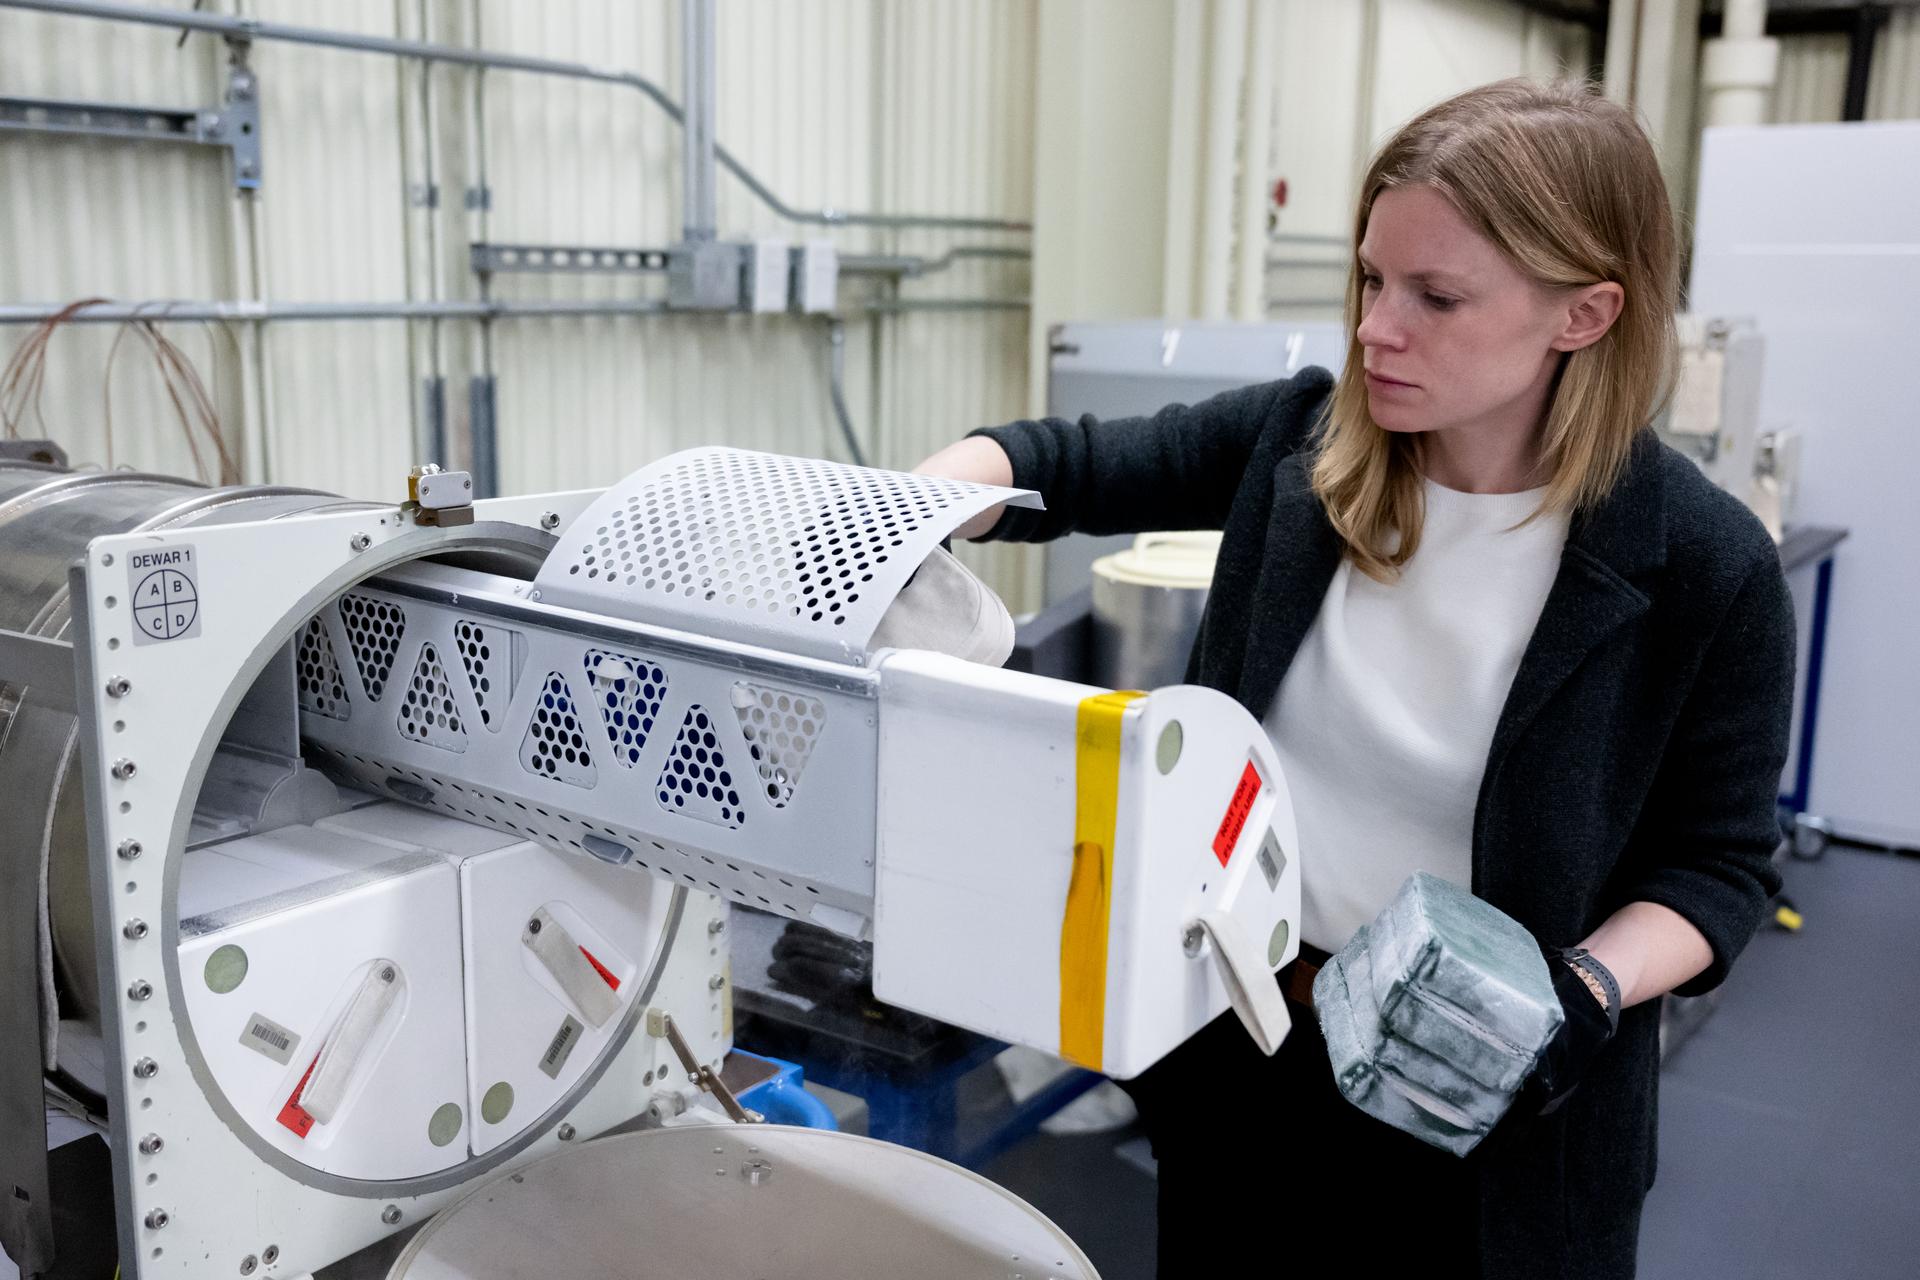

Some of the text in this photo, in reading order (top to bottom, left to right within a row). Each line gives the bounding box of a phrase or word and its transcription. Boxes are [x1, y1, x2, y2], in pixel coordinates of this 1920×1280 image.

[133, 550, 190, 568] DEWAR 1
[151, 580, 182, 596] A B
[153, 615, 185, 630] C D
[1220, 808, 1235, 838] NOT
